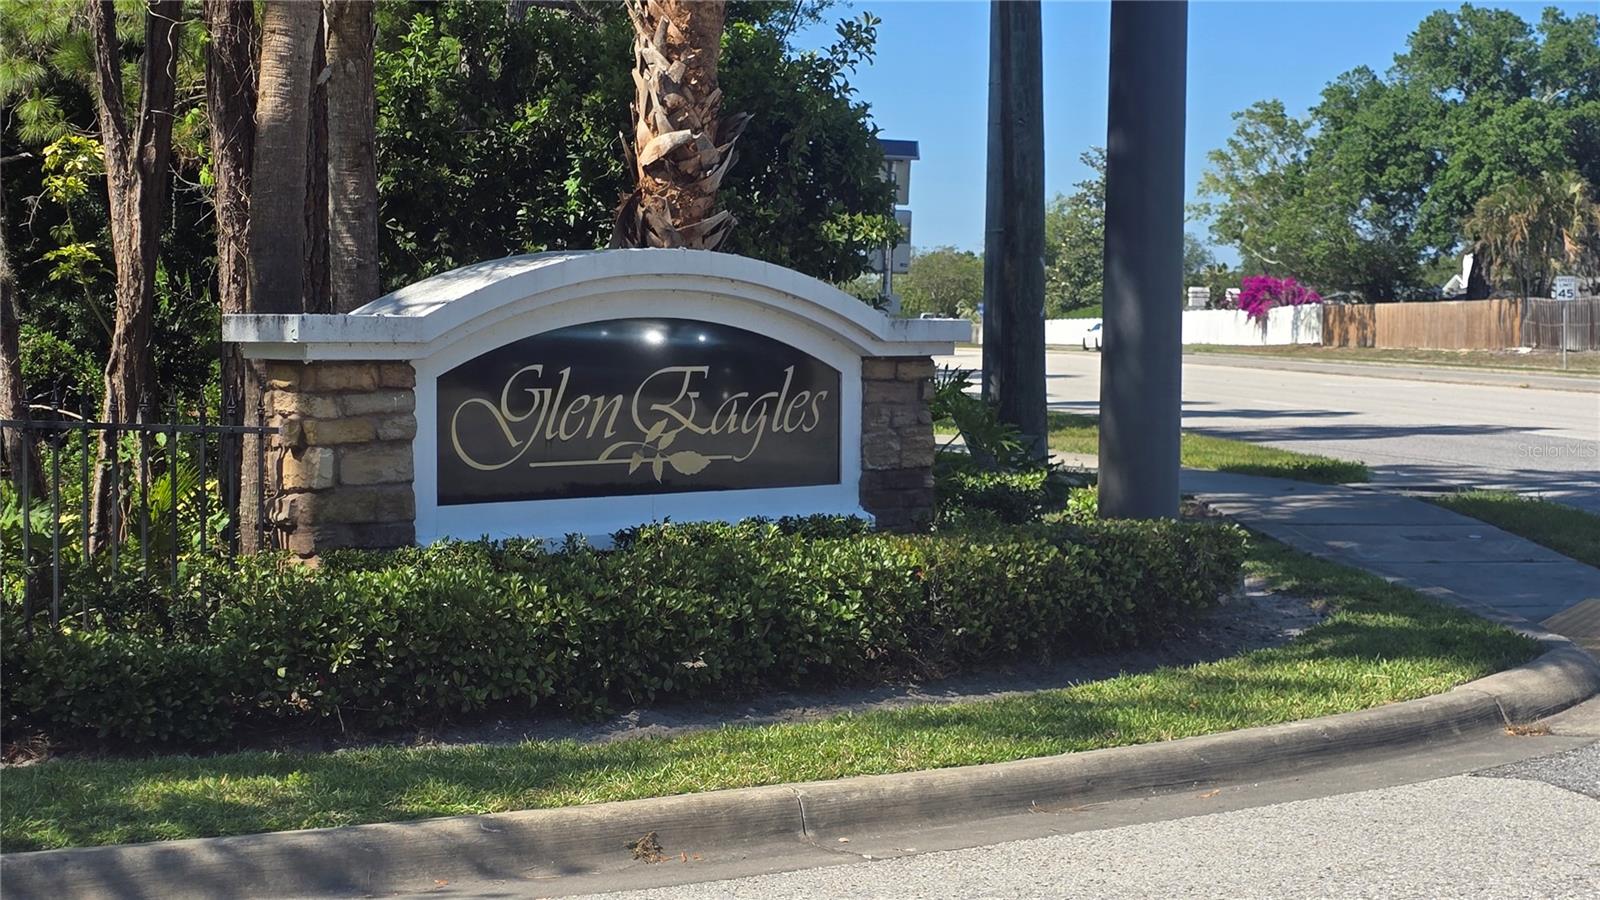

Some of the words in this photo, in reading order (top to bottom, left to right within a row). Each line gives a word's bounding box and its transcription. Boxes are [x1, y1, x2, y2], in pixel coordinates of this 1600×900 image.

[1558, 289, 1574, 298] 45
[451, 363, 625, 471] Glen
[631, 364, 829, 463] Eagles
